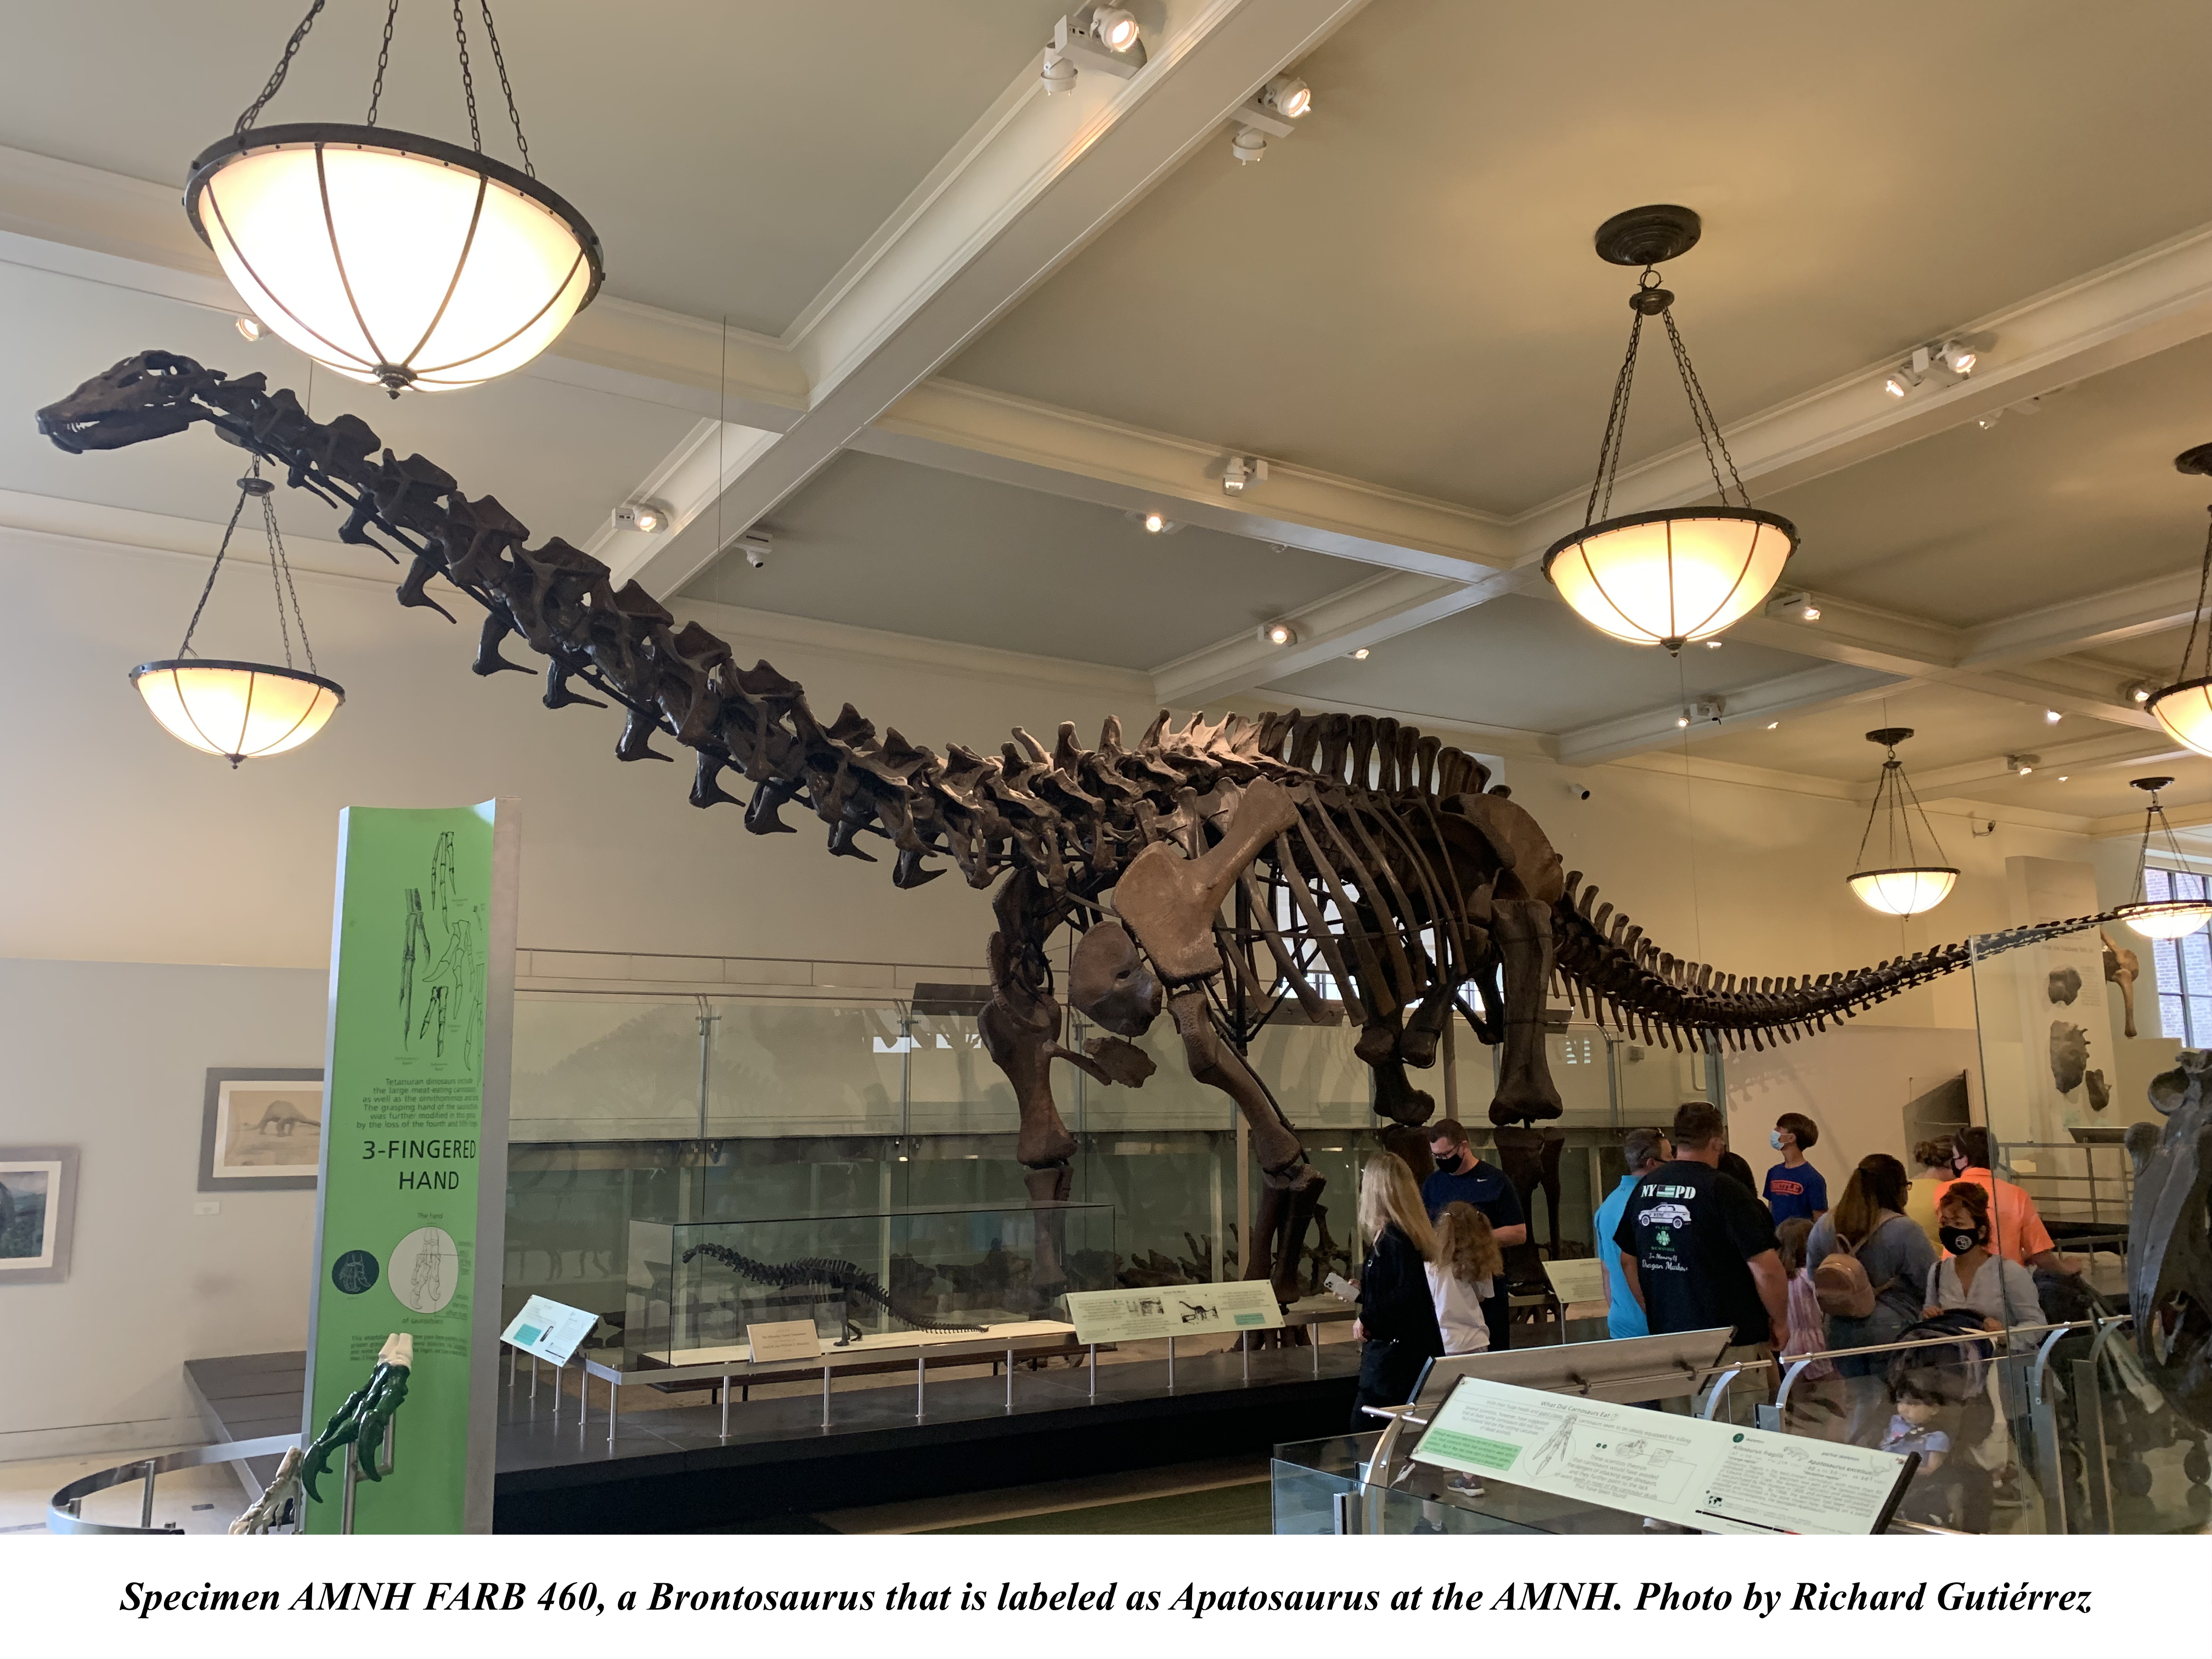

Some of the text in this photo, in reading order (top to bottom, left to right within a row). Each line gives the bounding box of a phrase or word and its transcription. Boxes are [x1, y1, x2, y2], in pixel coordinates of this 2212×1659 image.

[381, 1104, 415, 1113] grasping
[357, 1121, 365, 1130] by
[363, 1139, 476, 1159] 3-FINGERED
[399, 1171, 459, 1190] HAND
[1641, 1184, 1696, 1199] NY PD
[1656, 1253, 1672, 1261] Memory
[1541, 1400, 1555, 1409] What
[1568, 1406, 1599, 1416] Carnosaurs
[1733, 1445, 1762, 1454] Allosaurus
[1583, 1460, 1610, 1469] carnosaurs
[1638, 1471, 1660, 1479] avoided
[1599, 1469, 1622, 1478] attacking
[1808, 1459, 1846, 1470] Apatosaurus
[1847, 1466, 1872, 1475] excelsus
